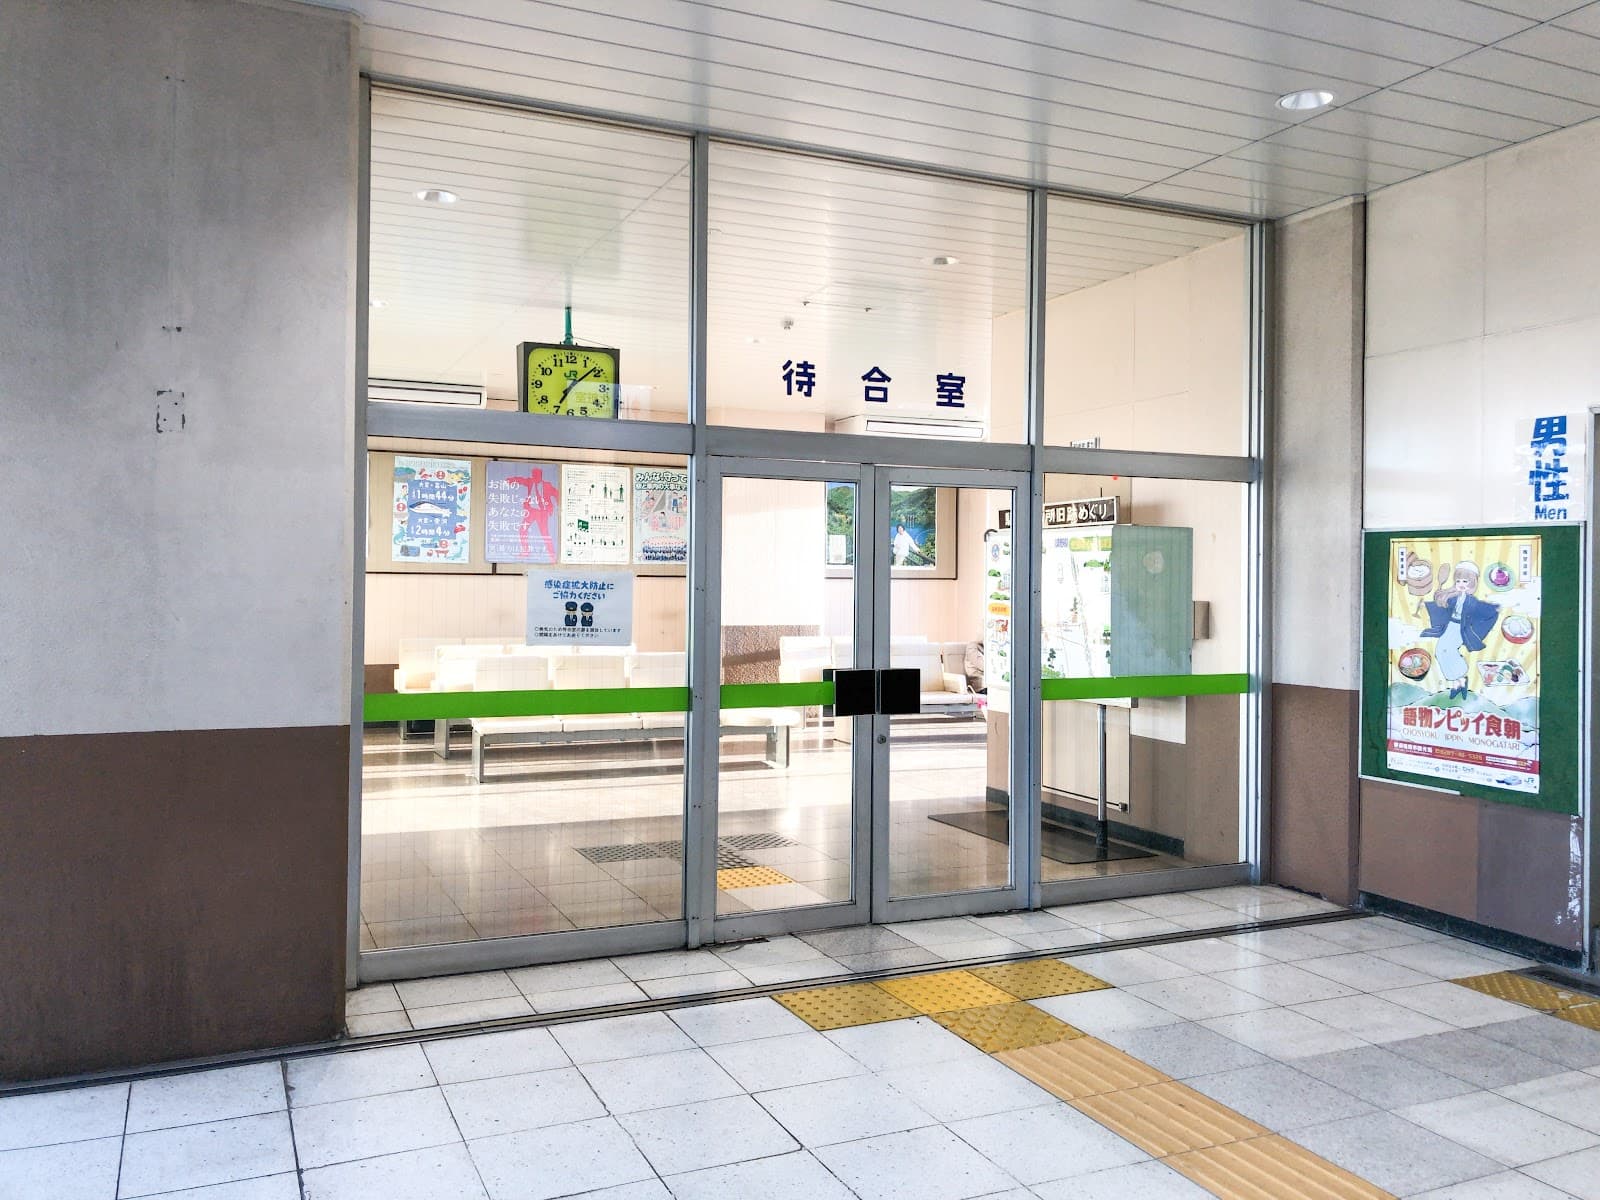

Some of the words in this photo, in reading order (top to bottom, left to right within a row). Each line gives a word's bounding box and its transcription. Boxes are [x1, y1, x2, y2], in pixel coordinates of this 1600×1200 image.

[553, 359, 563, 367] 11
[566, 356, 577, 364] 12
[583, 360, 587, 368] 1
[541, 367, 552, 376] 10
[564, 371, 578, 379] JR
[593, 370, 601, 378] 2
[535, 380, 542, 388] 9
[782, 359, 966, 408] 待合室
[599, 385, 606, 393] 3
[541, 395, 548, 403] 8
[553, 405, 560, 413] 7
[580, 407, 587, 415] 5
[1528, 415, 1569, 502] 男性
[488, 479, 520, 491] お酒の
[488, 507, 530, 518] あなたの
[1535, 504, 1568, 520] Men
[544, 579, 614, 591] 感染症拡大防止に
[552, 590, 606, 600] ご協力ください
[1468, 737, 1521, 751] MONOGATARI
